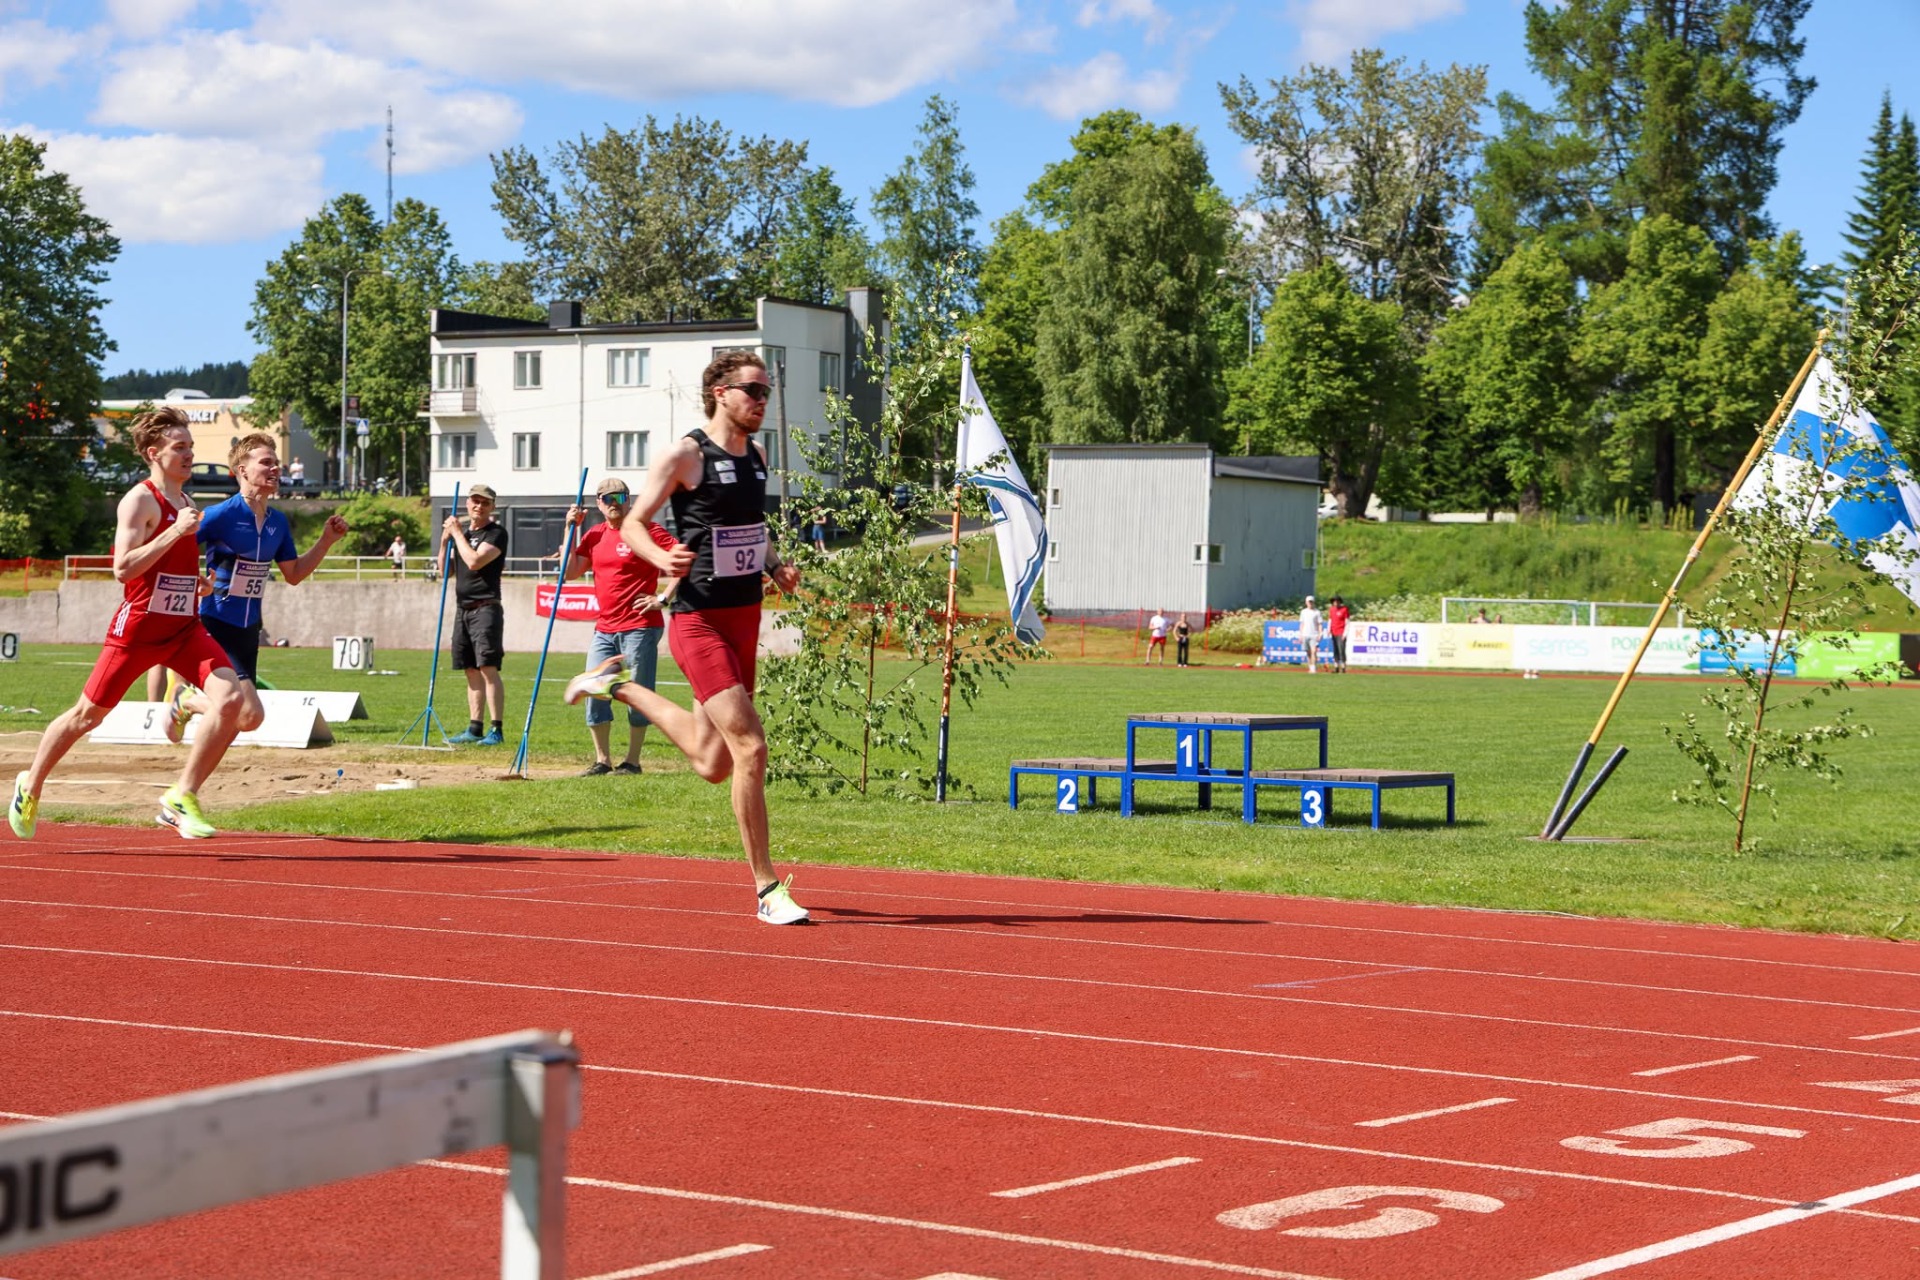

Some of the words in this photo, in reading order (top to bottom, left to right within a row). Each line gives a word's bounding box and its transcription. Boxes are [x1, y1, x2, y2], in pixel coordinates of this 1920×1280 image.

[186, 409, 217, 422] RKET
[735, 549, 755, 571] 92
[245, 579, 262, 594] 55
[164, 593, 187, 612] 122
[1368, 625, 1418, 643] Rauta
[1611, 636, 1641, 650] POP
[1650, 637, 1688, 651] ankki
[336, 638, 360, 668] 70
[143, 708, 155, 730] 5
[1179, 734, 1193, 767] 1
[1058, 778, 1077, 811] 2
[1303, 790, 1323, 824] 3
[1559, 1117, 1810, 1159] 5
[1215, 1185, 1505, 1240] 6
